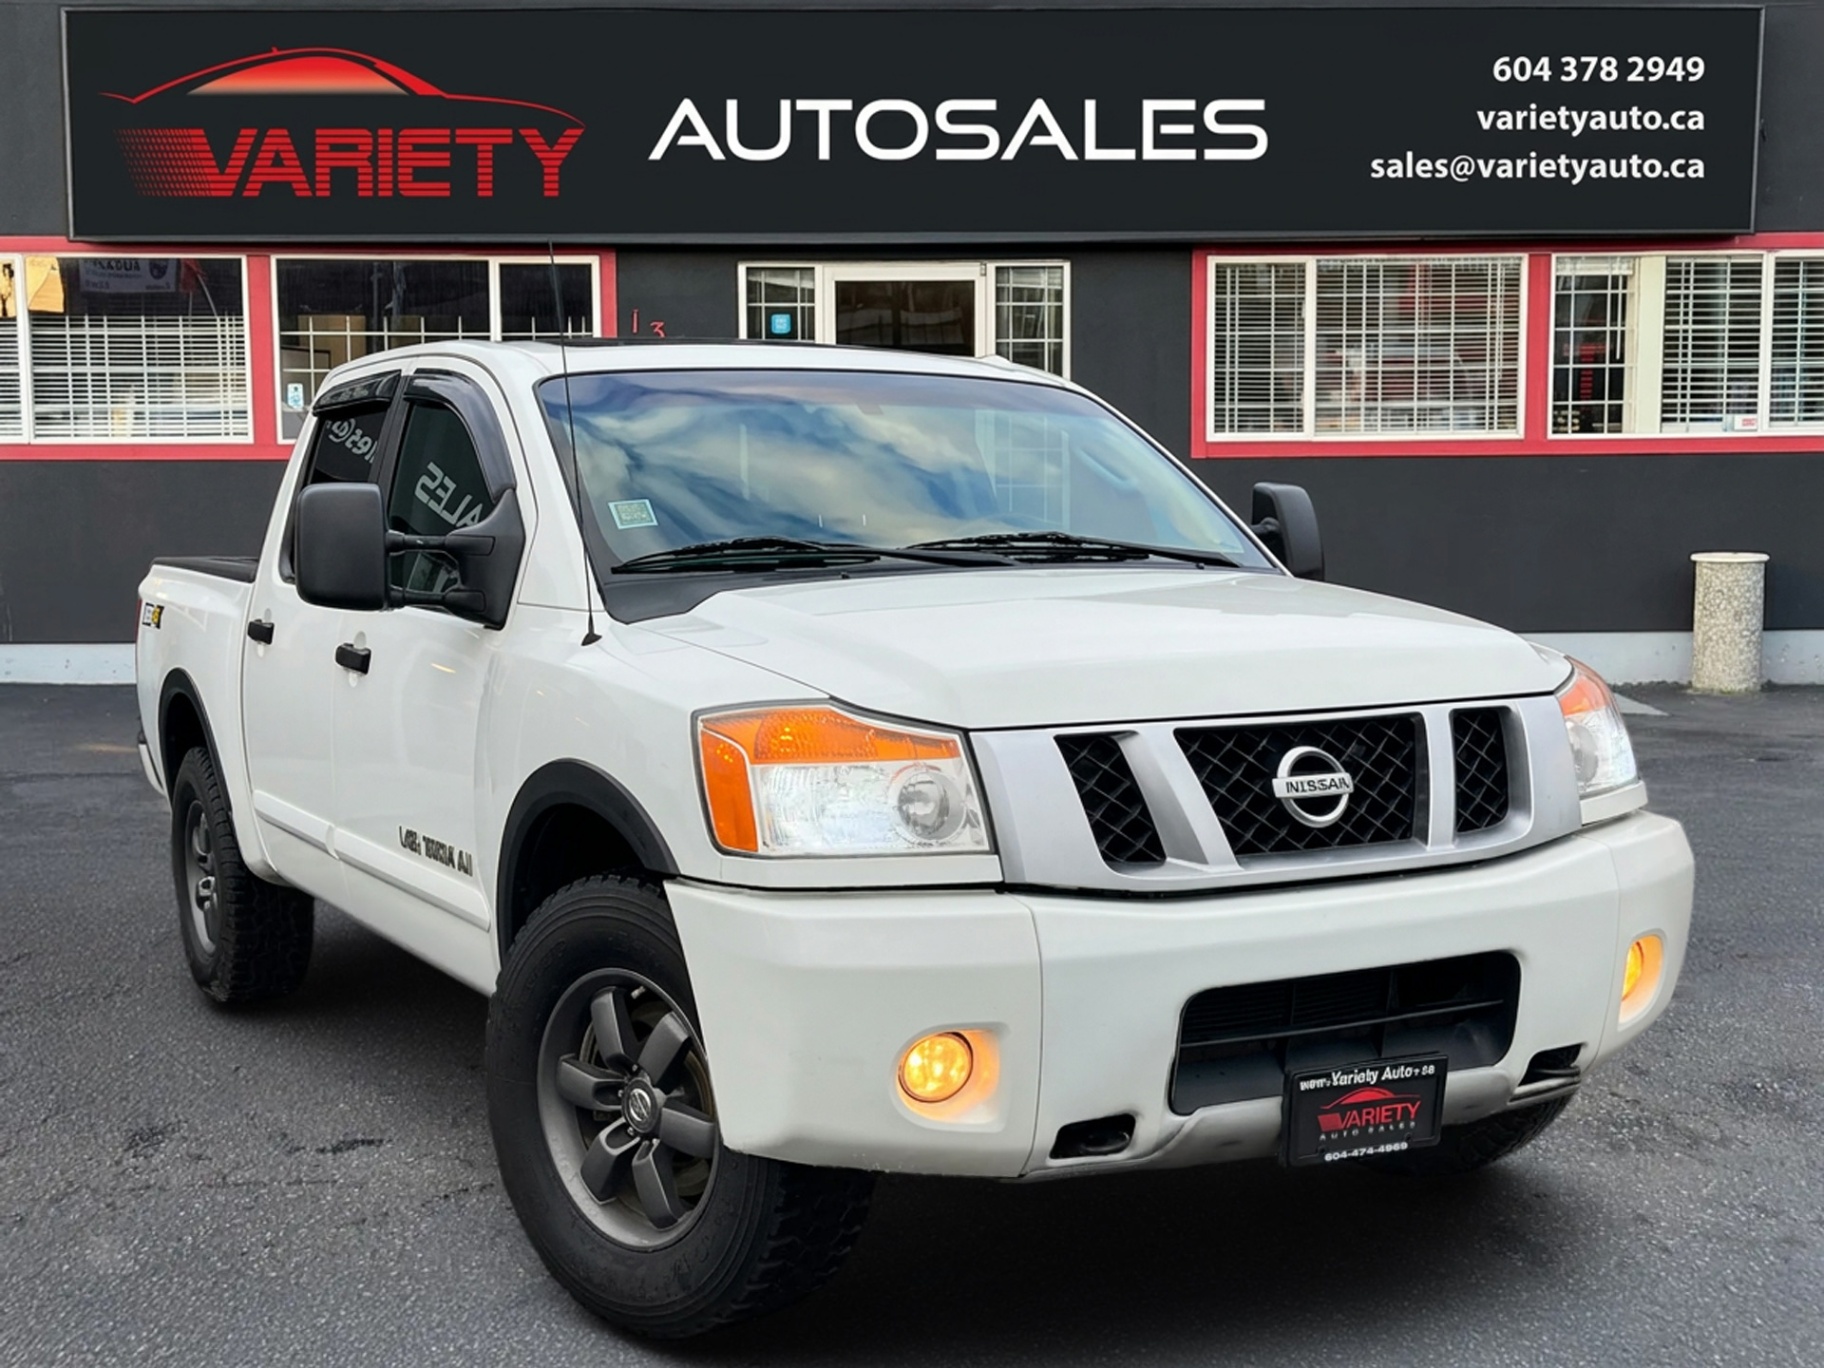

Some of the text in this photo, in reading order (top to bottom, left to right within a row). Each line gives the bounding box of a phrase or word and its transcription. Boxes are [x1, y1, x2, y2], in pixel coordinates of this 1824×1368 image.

[1493, 56, 1705, 82] 604 378 2949
[648, 97, 1269, 161] AUTOSALES
[1476, 103, 1705, 137] varietyauto.ca
[113, 128, 585, 197] VARIETY
[1370, 151, 1705, 185] sales@varietyauto.ca
[1285, 777, 1350, 793] NISSAN
[1317, 1100, 1421, 1132] VARIETY
